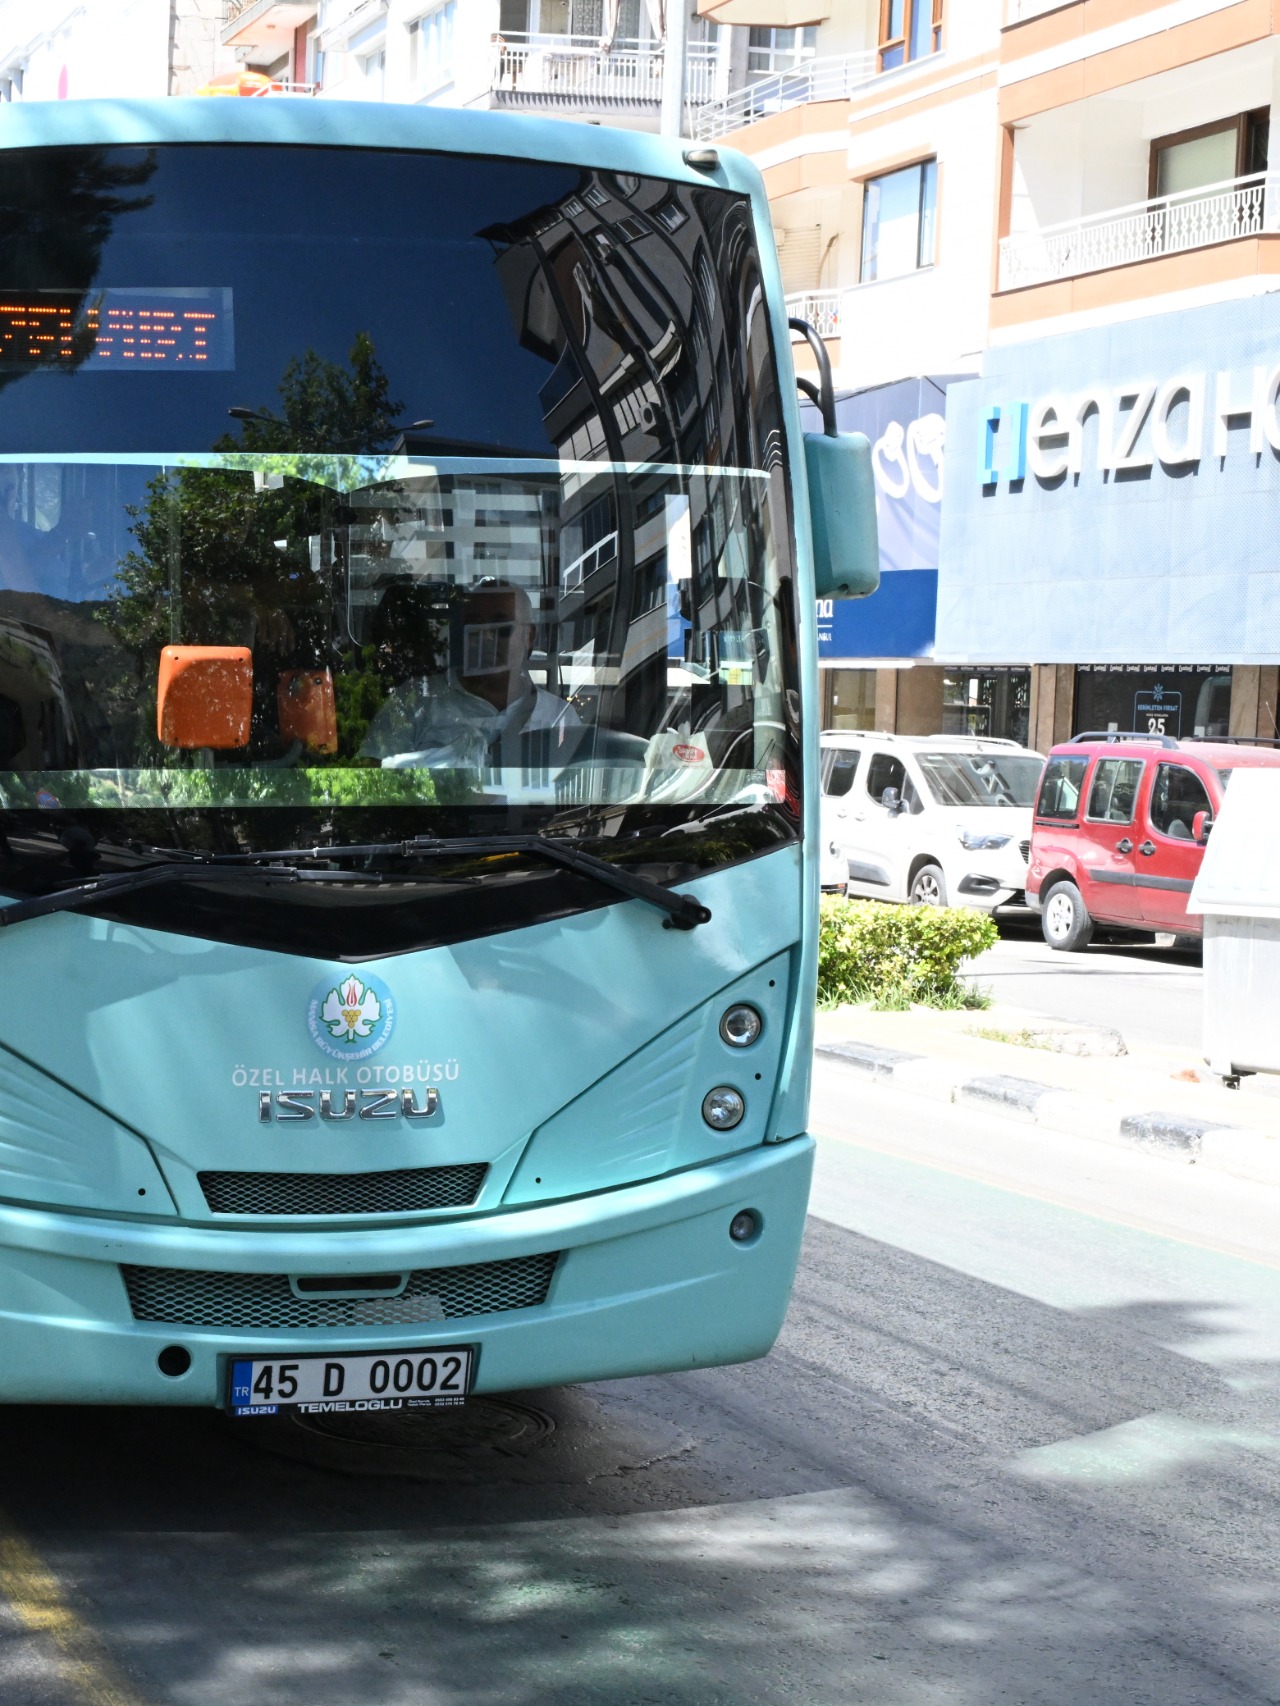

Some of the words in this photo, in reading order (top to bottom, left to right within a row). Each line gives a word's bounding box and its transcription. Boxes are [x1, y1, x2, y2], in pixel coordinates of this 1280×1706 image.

[1214, 363, 1280, 465] H
[232, 1064, 285, 1087] ÖZEL
[292, 1067, 349, 1086] HALK
[356, 1058, 460, 1084] OTOBÜSÜ
[259, 1086, 438, 1123] ISUZU
[234, 1386, 249, 1397] TR
[253, 1364, 300, 1400] 45
[322, 1362, 345, 1397] D
[370, 1356, 462, 1394] 0002
[238, 1406, 276, 1416] ISUZU
